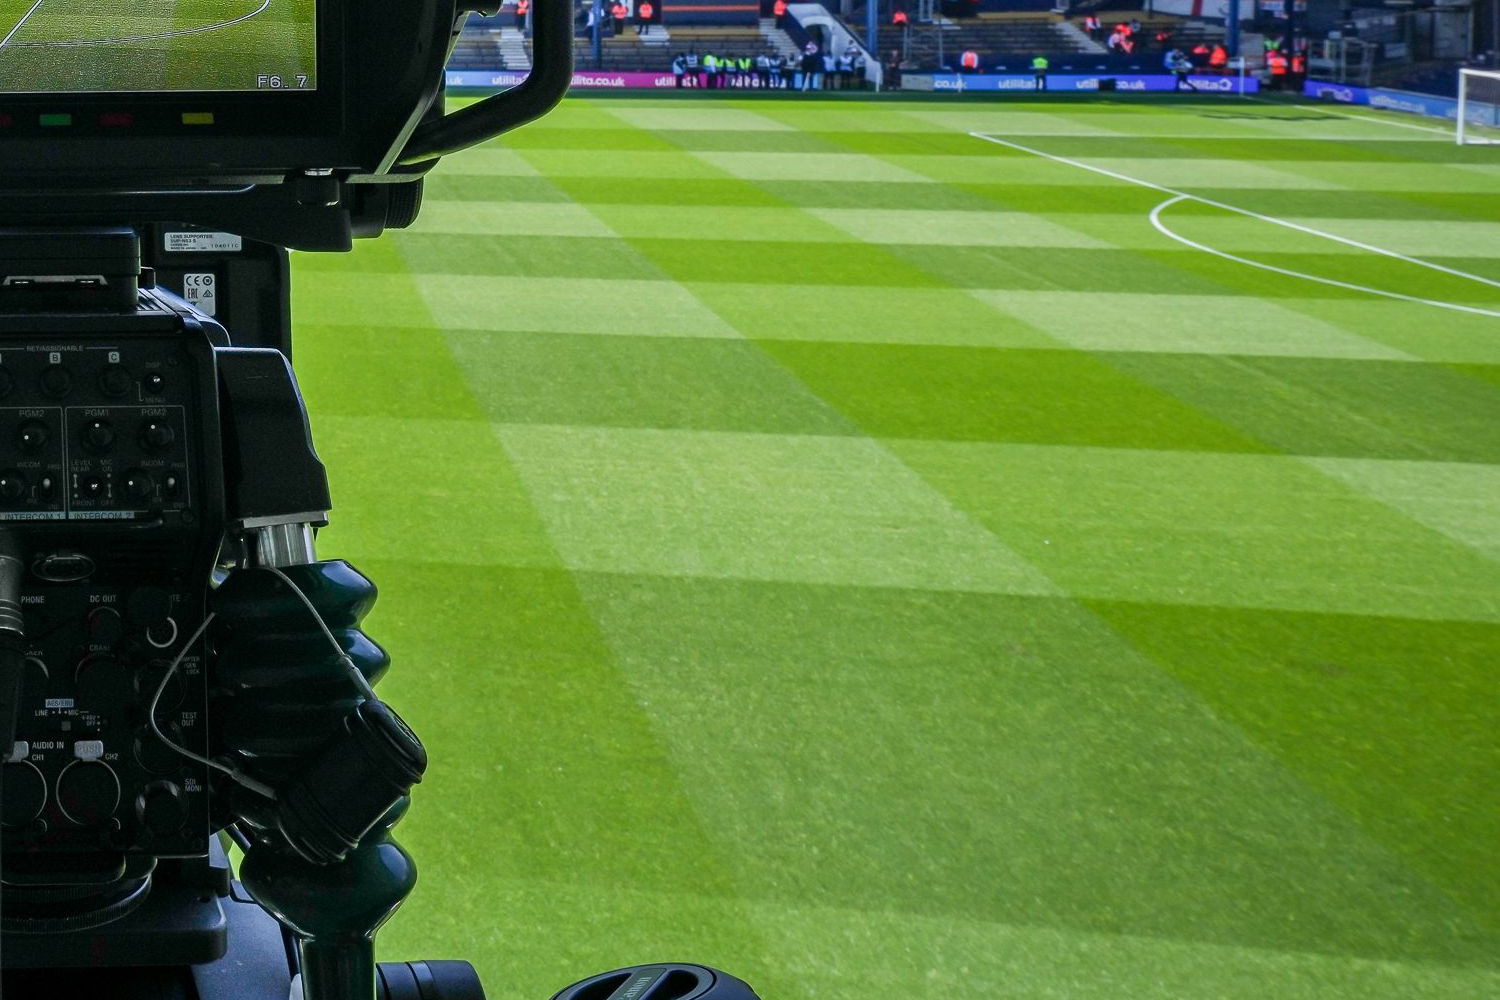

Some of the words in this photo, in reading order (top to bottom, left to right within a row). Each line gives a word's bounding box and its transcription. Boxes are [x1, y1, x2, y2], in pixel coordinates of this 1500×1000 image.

[19, 410, 44, 418] PGM2
[85, 409, 109, 417] PGM1
[141, 408, 167, 416] PGM2
[21, 596, 45, 604] PHONE
[181, 719, 194, 727] OUT
[32, 741, 54, 749] AUDIO
[56, 741, 64, 749] IN
[184, 784, 202, 792] MONI
